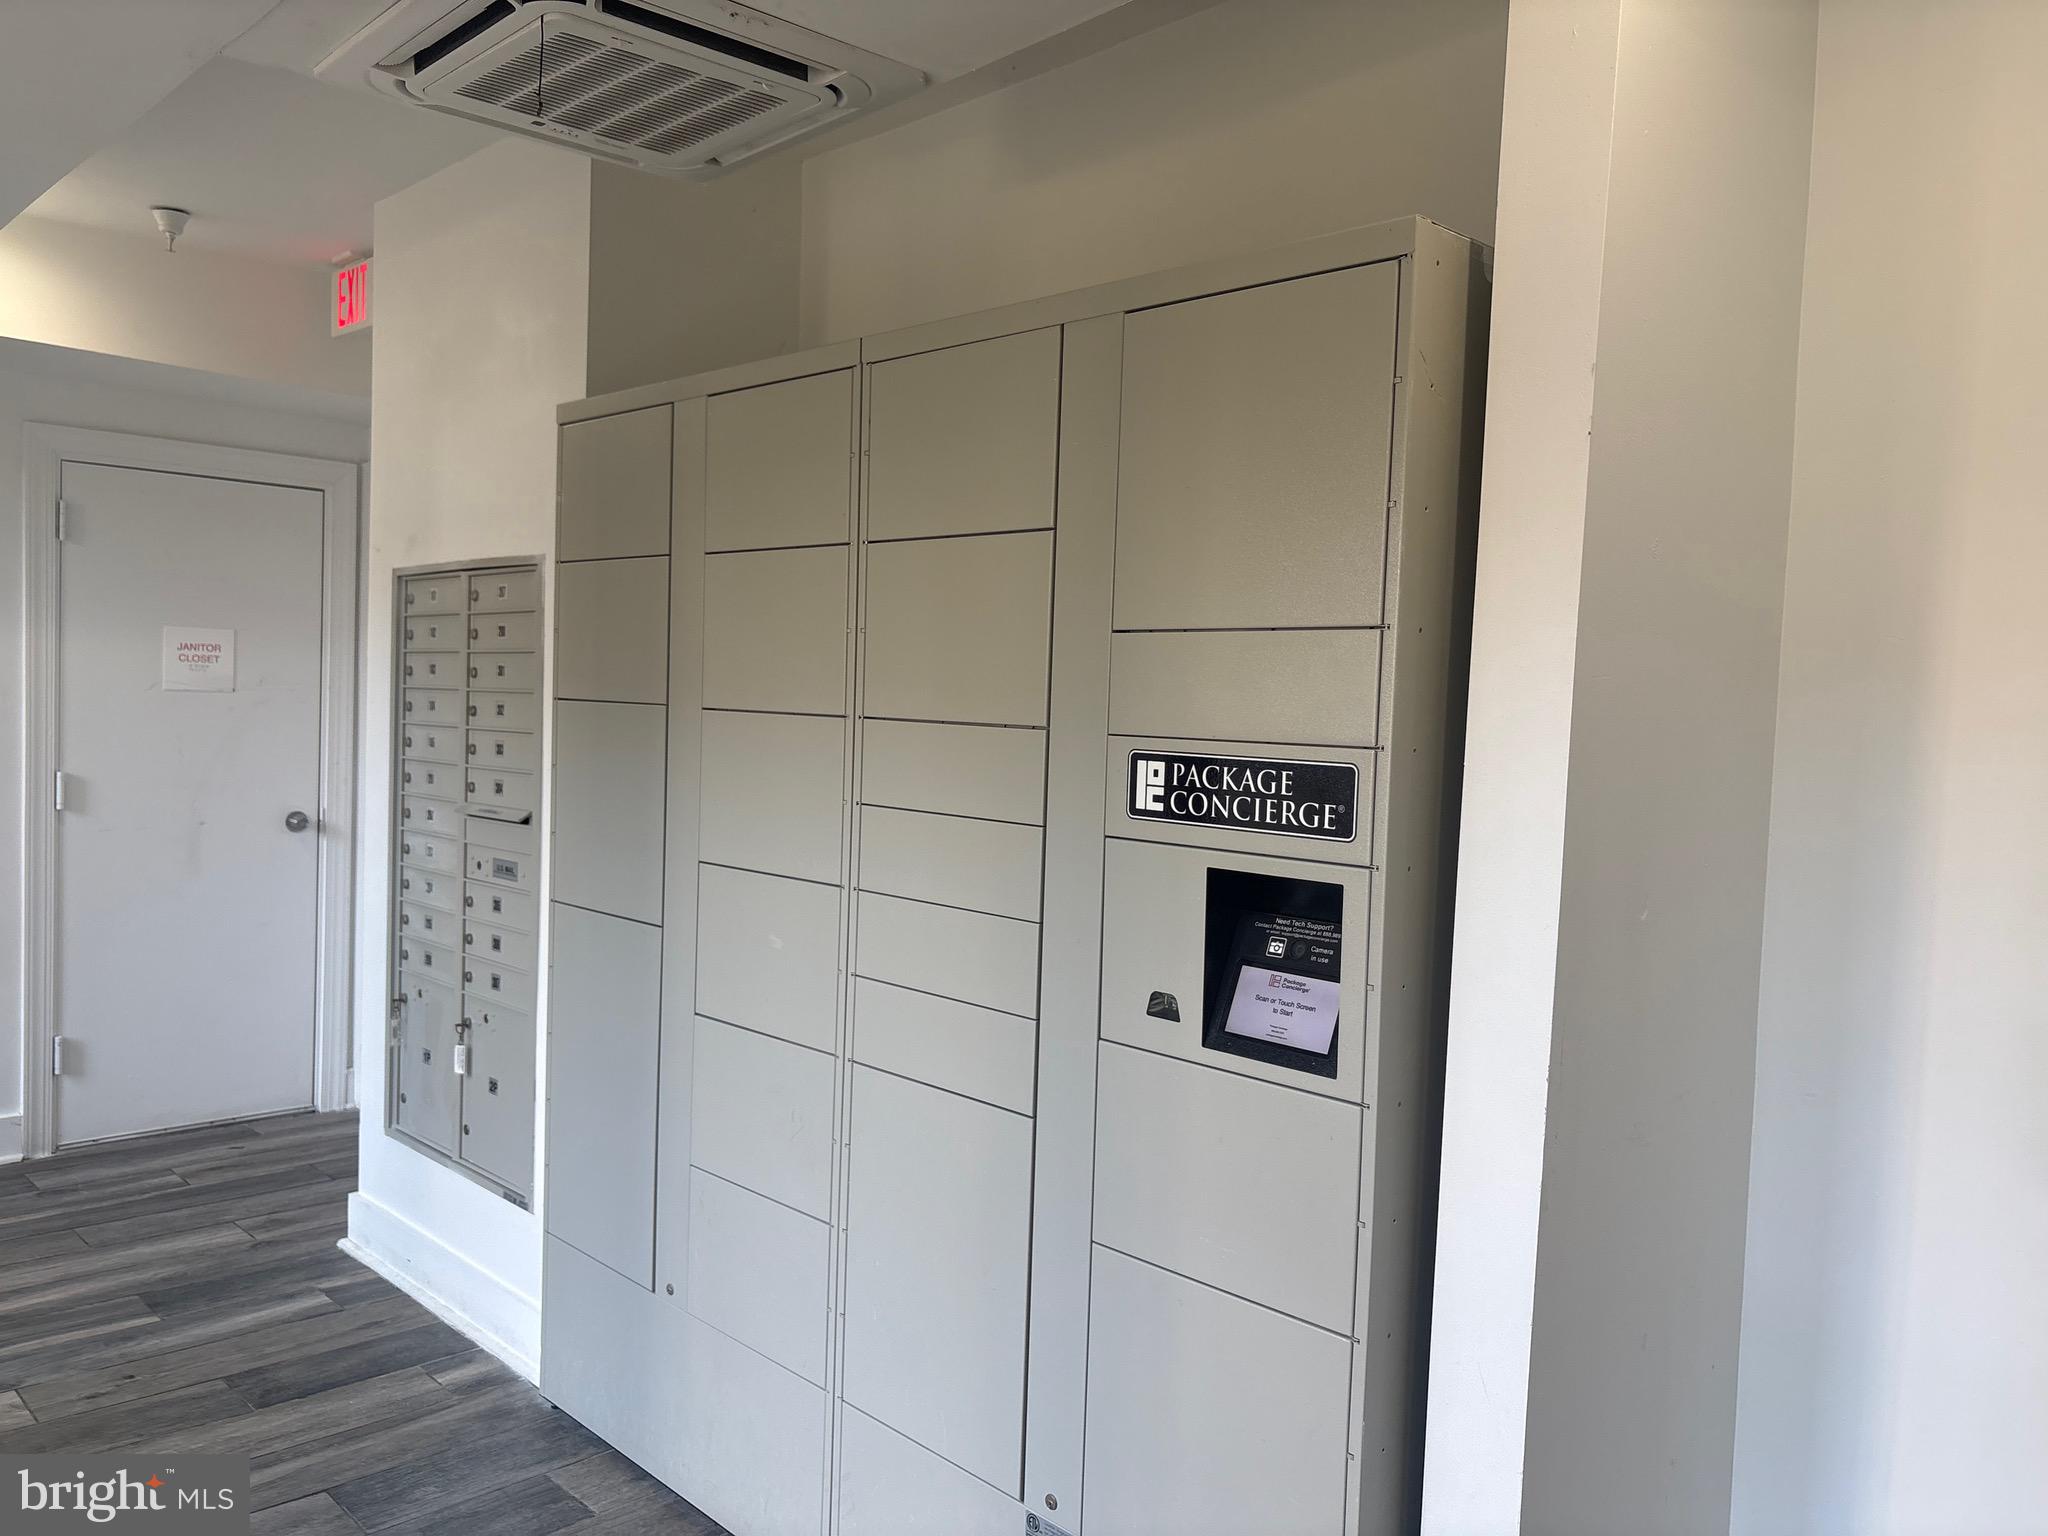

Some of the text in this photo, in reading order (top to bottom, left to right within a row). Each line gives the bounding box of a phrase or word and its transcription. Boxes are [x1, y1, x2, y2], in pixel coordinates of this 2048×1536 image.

[338, 262, 368, 329] EXIT
[177, 642, 222, 653] JANITOR
[178, 654, 220, 664] CLOSET
[1172, 762, 1294, 797] PACKAGE
[1275, 917, 1290, 926] Need
[1306, 922, 1335, 931] Support?
[1310, 944, 1334, 955] Camera
[1282, 978, 1306, 987] Package
[1254, 994, 1270, 1003] Scan
[1278, 998, 1294, 1008] Touch
[1295, 1002, 1317, 1013] Screen
[1279, 1008, 1294, 1017] Start
